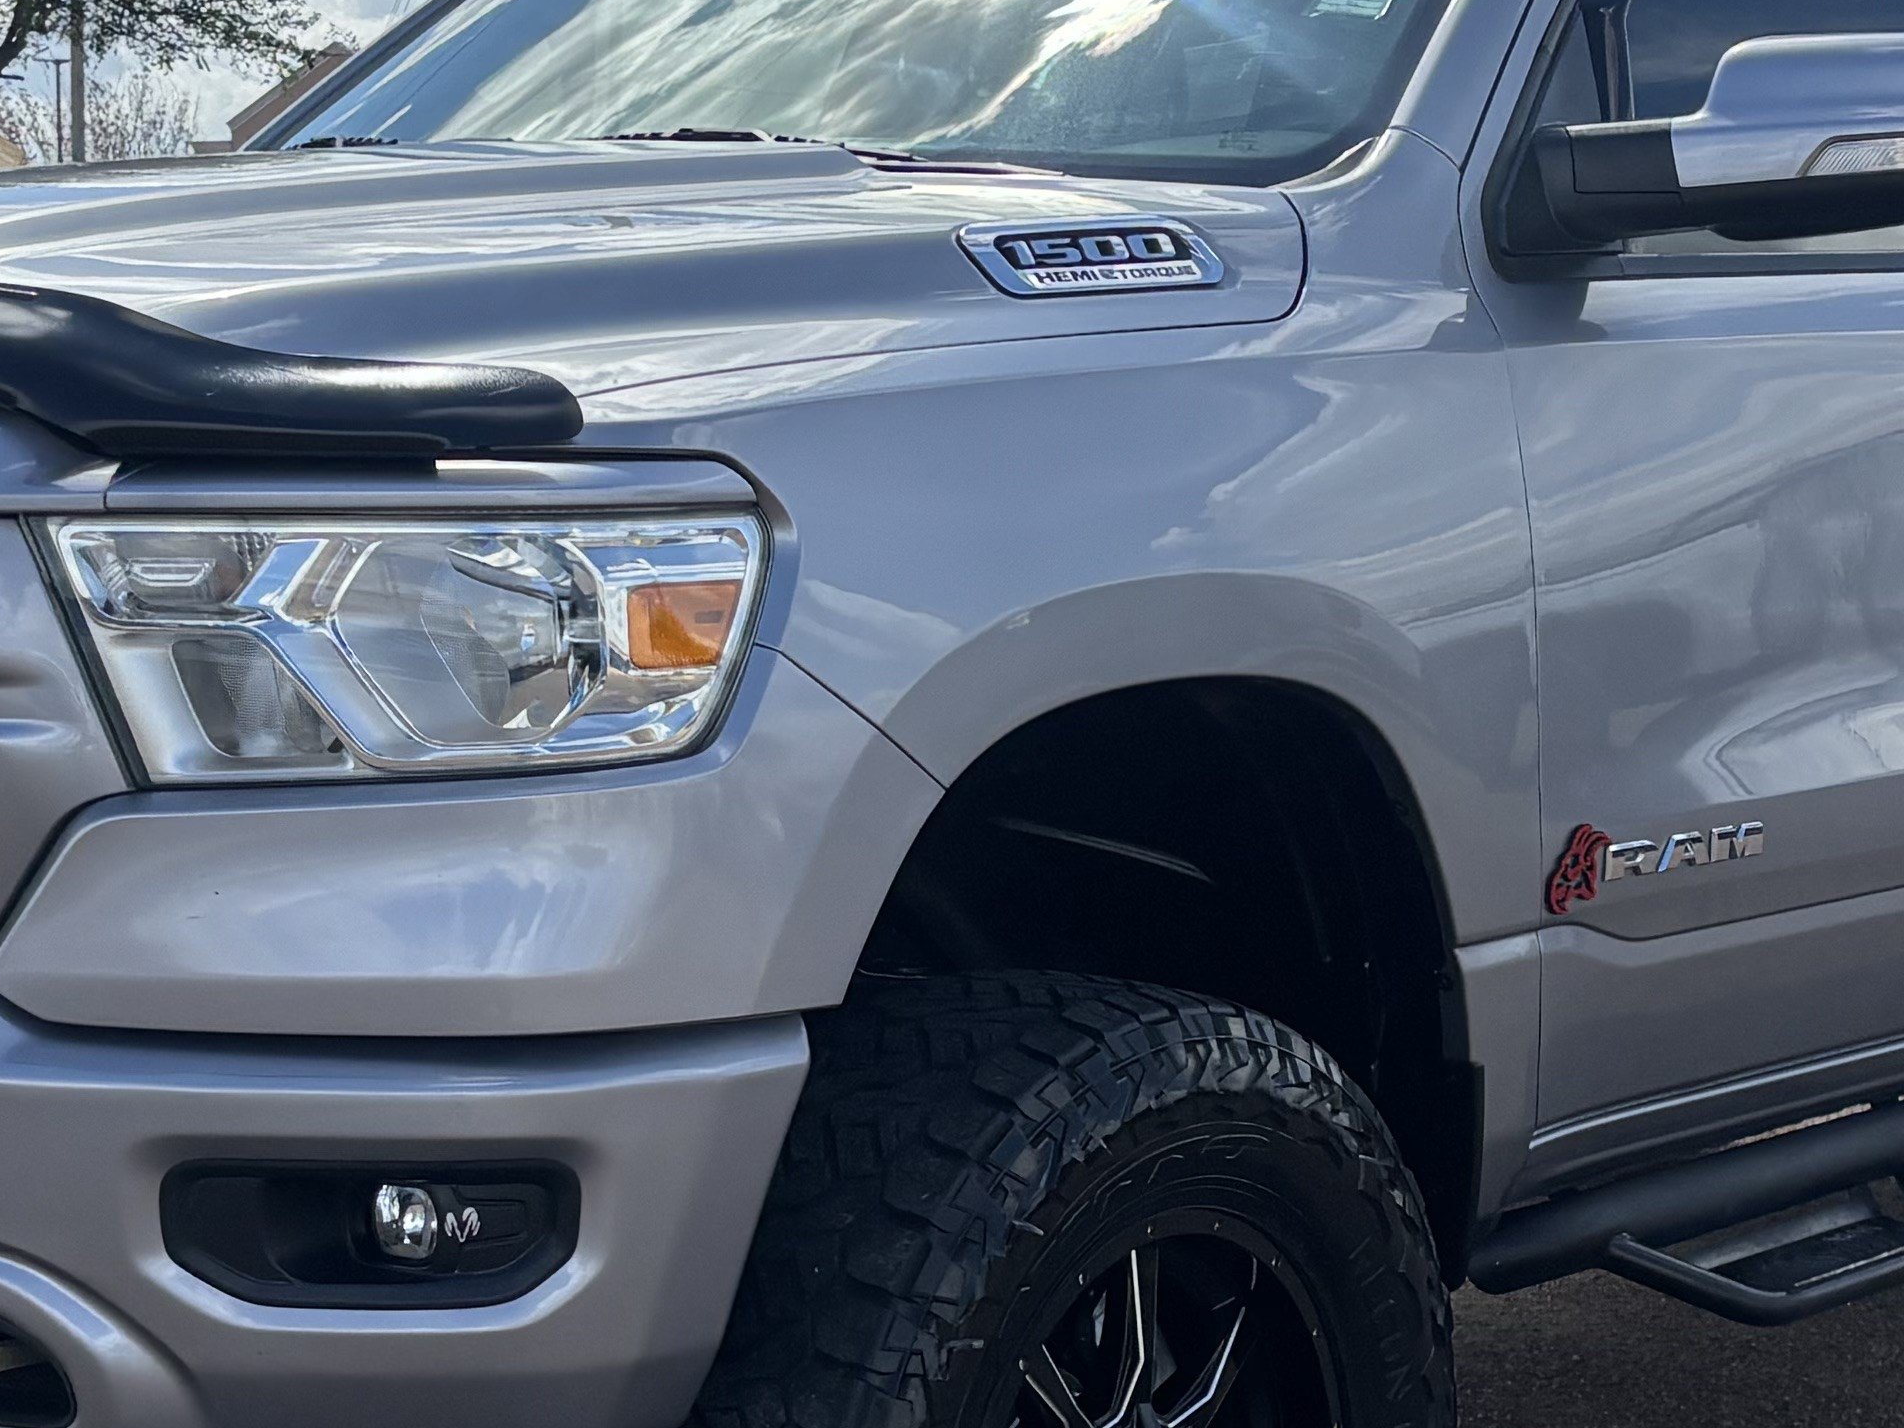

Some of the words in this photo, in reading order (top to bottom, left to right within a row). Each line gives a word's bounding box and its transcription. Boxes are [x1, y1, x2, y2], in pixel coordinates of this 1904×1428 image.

[1002, 232, 1177, 267] 1500
[1034, 270, 1099, 284] HEMI
[1604, 821, 1765, 882] RAM
